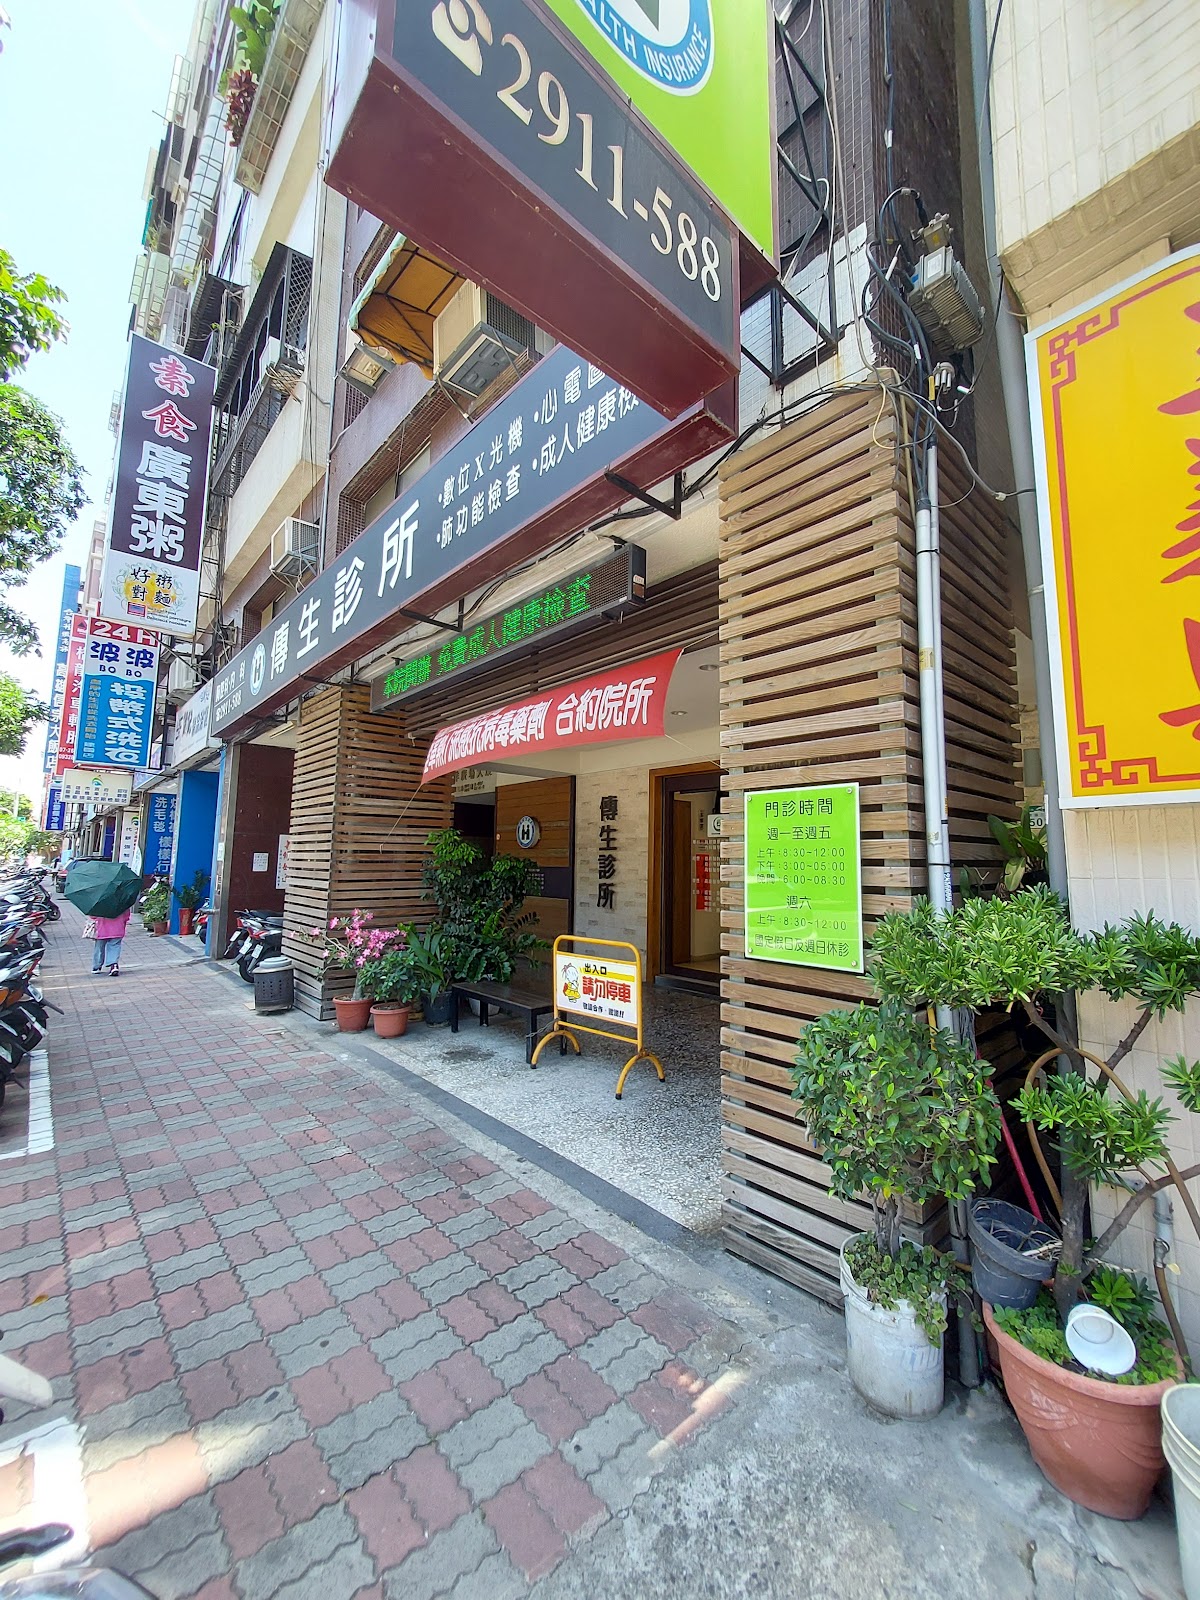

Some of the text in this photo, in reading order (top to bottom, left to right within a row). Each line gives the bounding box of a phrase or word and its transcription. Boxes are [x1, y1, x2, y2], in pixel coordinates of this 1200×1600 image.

[643, 22, 708, 83] INSURANCE
[497, 33, 720, 302] 2911-588
[129, 355, 197, 563] 素食 廣東粥
[440, 464, 521, 549] 肺功能檢查
[270, 499, 420, 680] 傳生診所
[92, 621, 131, 640] 24
[137, 628, 157, 646] H
[90, 641, 155, 669] 波波
[99, 664, 142, 678] BO BO
[555, 676, 657, 736] 合約院所
[104, 681, 148, 764] 投幣式洗衣
[765, 797, 833, 819] 門診時間
[767, 825, 831, 842] 週一至週五
[596, 795, 619, 910] 傳生診所
[786, 895, 812, 910] 週六
[754, 934, 850, 958] 國定假日及週日休診
[584, 962, 608, 975] 出入口
[582, 975, 632, 1003] 請勿停車
